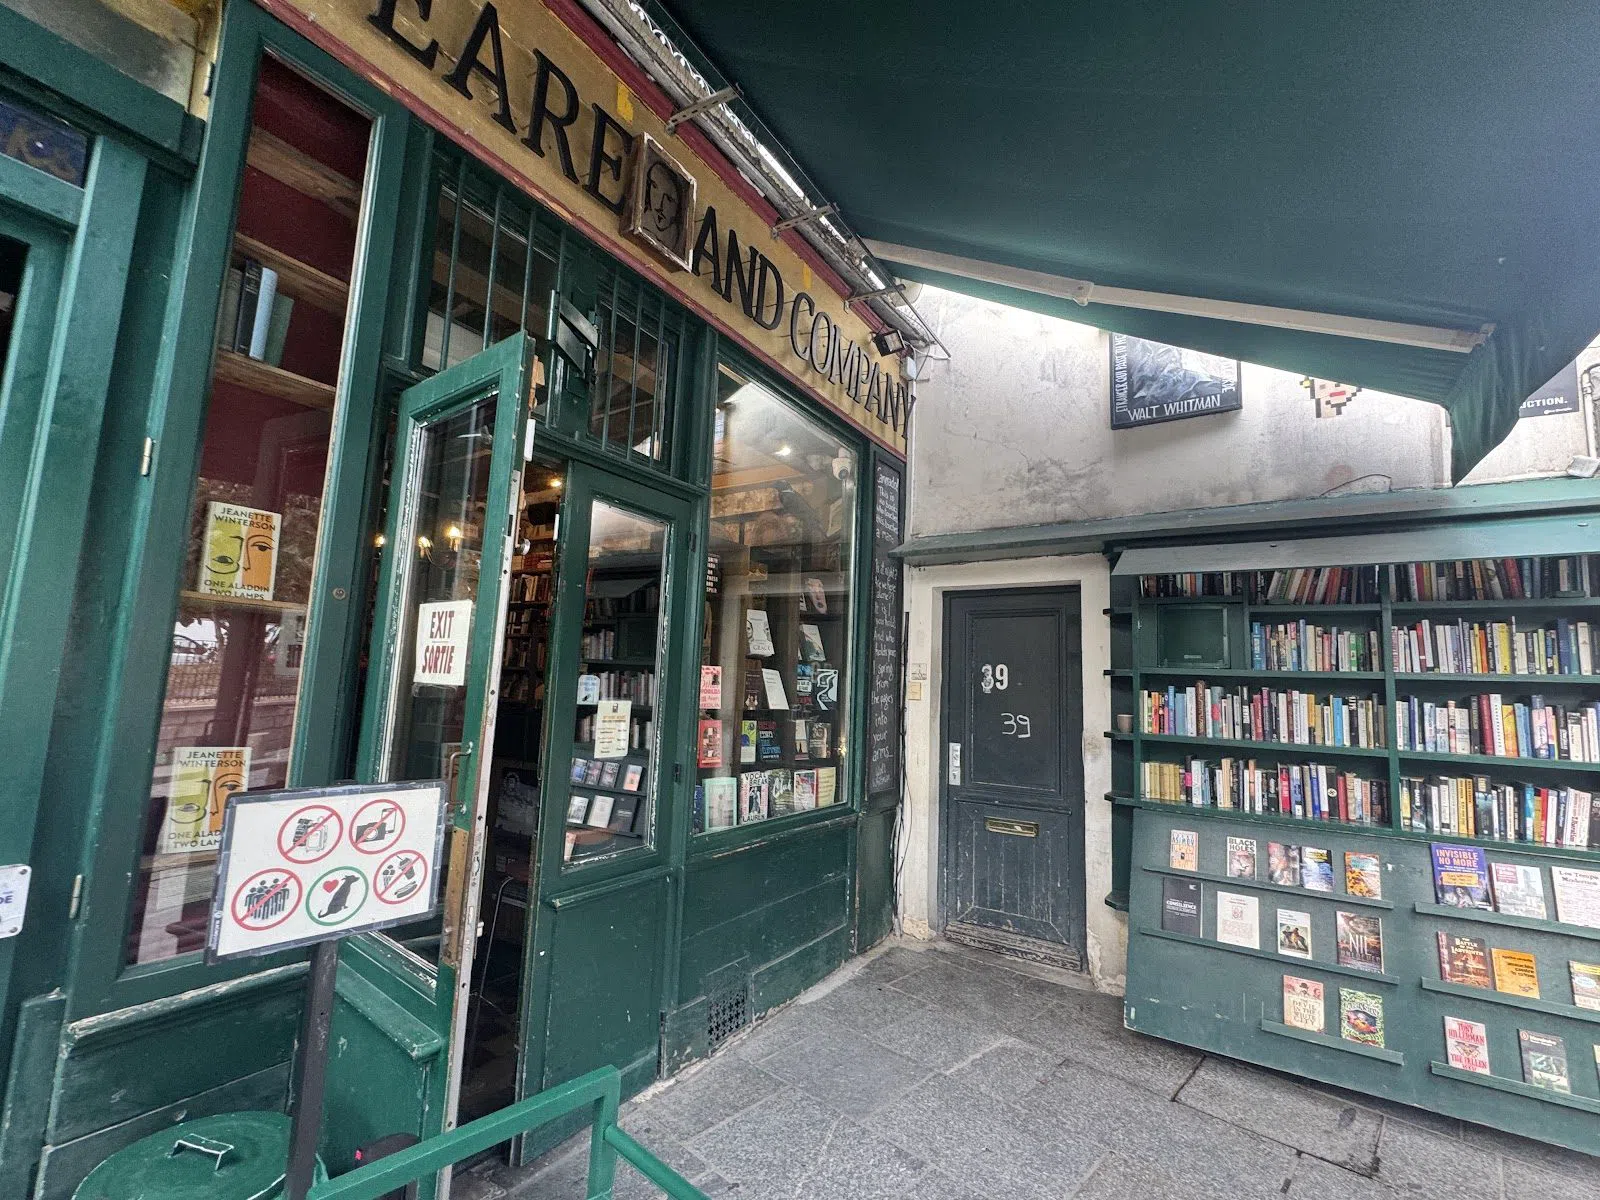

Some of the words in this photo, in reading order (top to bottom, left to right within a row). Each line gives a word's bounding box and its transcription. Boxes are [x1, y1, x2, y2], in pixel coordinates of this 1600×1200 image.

[693, 206, 783, 330] AND
[790, 291, 917, 441] COMPANY
[1128, 405, 1160, 421] WALT
[1164, 393, 1220, 416] WHITMAN
[213, 513, 276, 531] WINTERSON
[220, 507, 273, 523] JEANETTE
[204, 579, 226, 588] ONE
[228, 582, 270, 593] ALADDIN
[209, 588, 232, 597] TWO
[234, 591, 265, 600] LAMPS
[429, 610, 455, 639] EXIT
[421, 645, 456, 674] SORTIE
[981, 663, 1009, 693] 39
[875, 711, 888, 728] into
[1001, 713, 1031, 739] 39
[872, 730, 888, 749] your
[186, 751, 242, 759] JEANETTE
[179, 759, 247, 768] WINTERSON
[168, 831, 192, 840] ONE
[1228, 837, 1256, 847] BLACK
[173, 839, 198, 849] TWO
[1229, 844, 1256, 853] HOLES
[1436, 849, 1479, 861] INVISIBLE
[1438, 857, 1450, 865] NO
[1453, 858, 1478, 868] MORE
